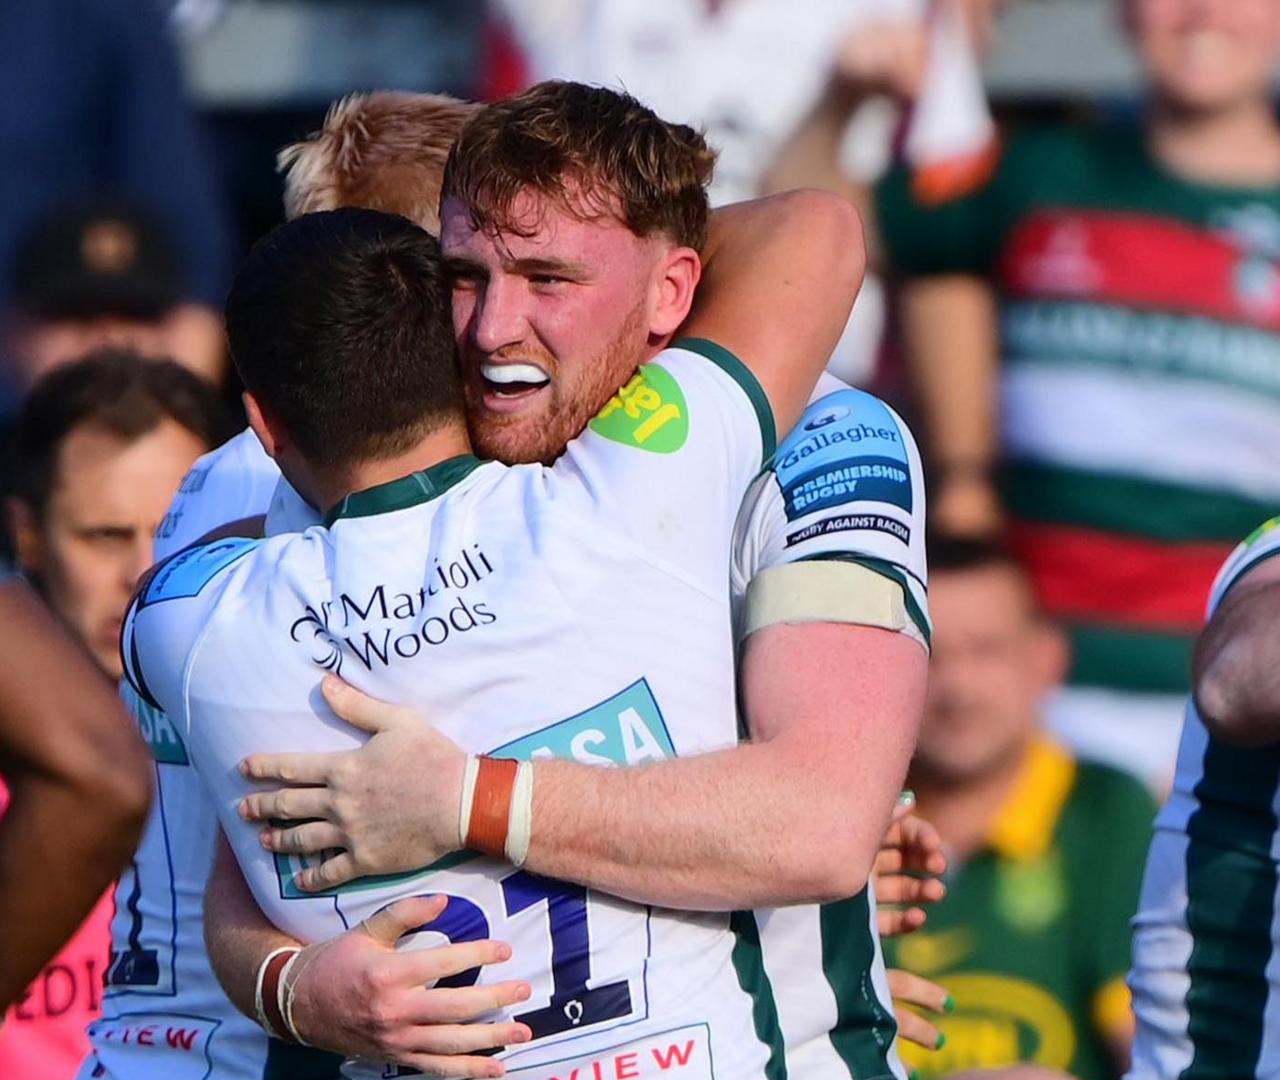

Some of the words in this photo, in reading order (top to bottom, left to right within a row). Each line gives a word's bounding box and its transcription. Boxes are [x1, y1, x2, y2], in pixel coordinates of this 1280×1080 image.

[781, 423, 898, 469] Gallagher
[792, 464, 908, 498] PREMIERSHIP
[792, 479, 859, 512] RUGBY
[825, 516, 876, 532] AGAINST
[876, 517, 910, 540] RACISM
[343, 596, 498, 671] Woods
